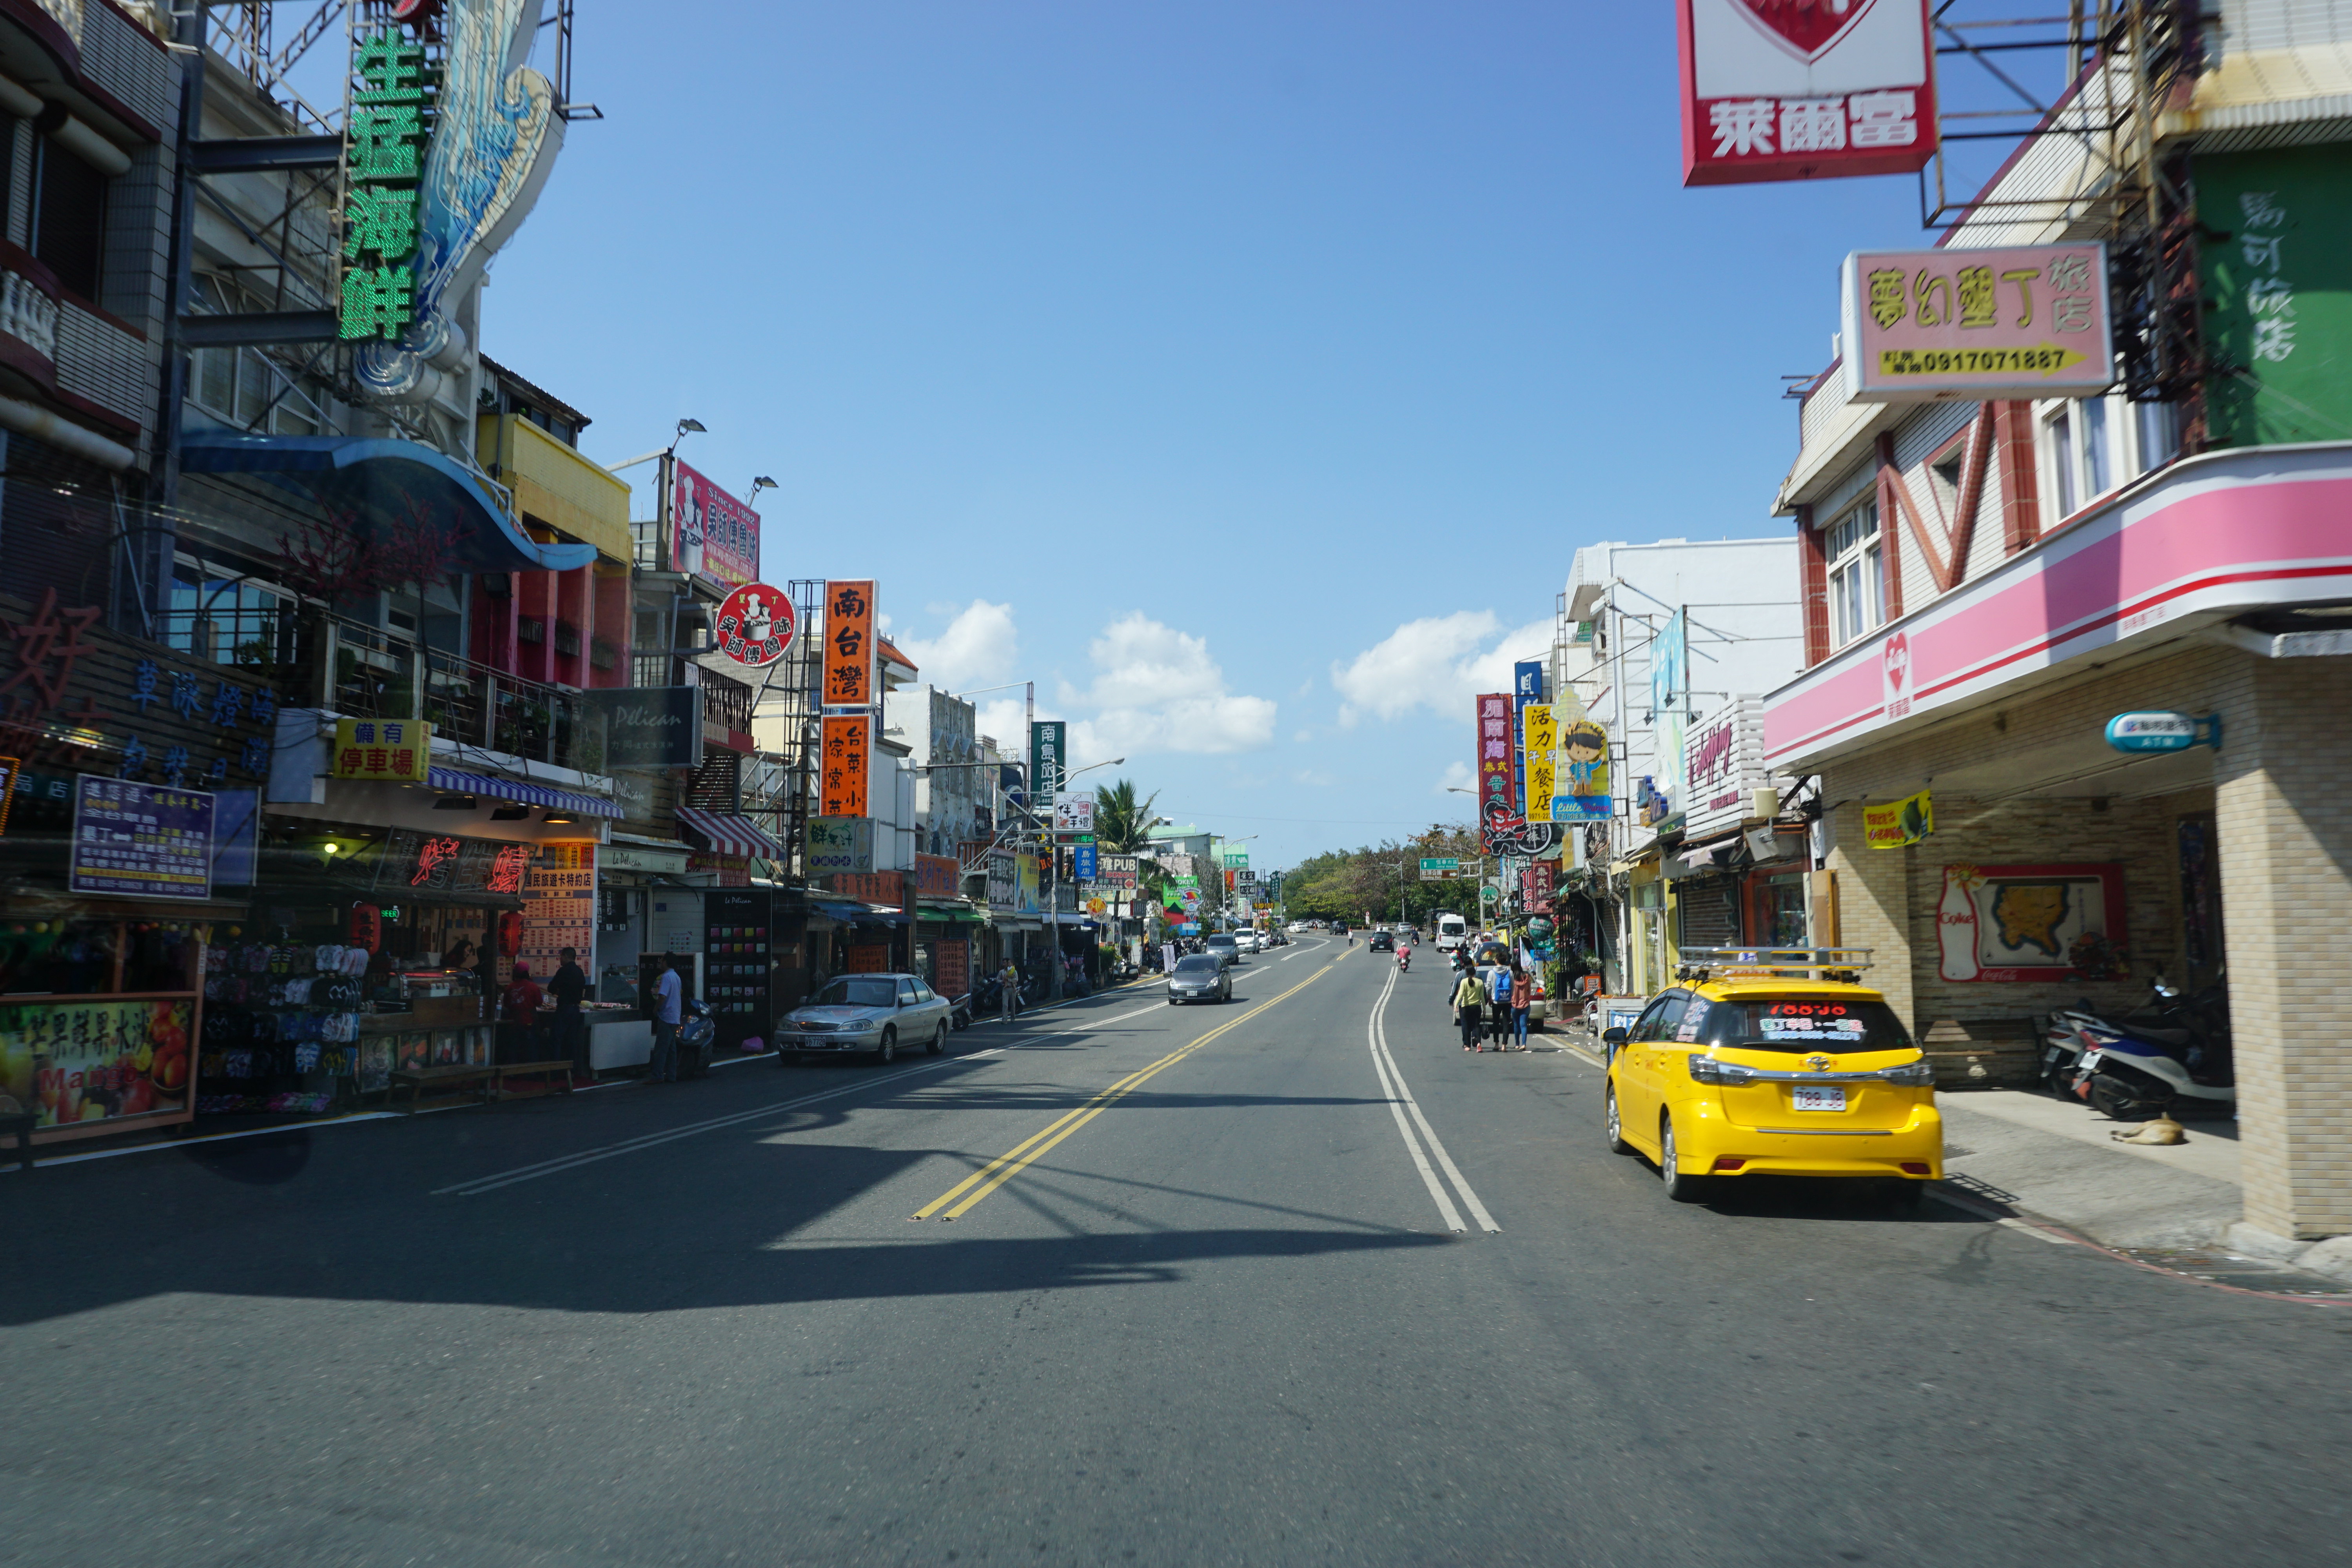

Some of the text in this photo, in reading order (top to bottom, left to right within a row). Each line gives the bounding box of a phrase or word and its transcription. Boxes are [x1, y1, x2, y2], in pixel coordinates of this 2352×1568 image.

[1710, 90, 1918, 158] 萊爾富
[339, 27, 426, 340] 生猛海鮮
[1869, 265, 2041, 331] 夢幻墾丁
[1924, 349, 2067, 371] 0917071887
[708, 486, 755, 526] Since 1992
[832, 588, 865, 697] 南台灣
[354, 722, 403, 744] 備有
[2142, 737, 2175, 747] ATM
[339, 747, 413, 775] 停車場
[1041, 724, 1055, 797] 南島旅店
[1484, 760, 1509, 773] 泰式
[1555, 802, 1610, 812] Little Prince
[1529, 923, 1552, 932] Heineken
[1941, 911, 1974, 926] Coke
[40, 1065, 137, 1091] Mango
